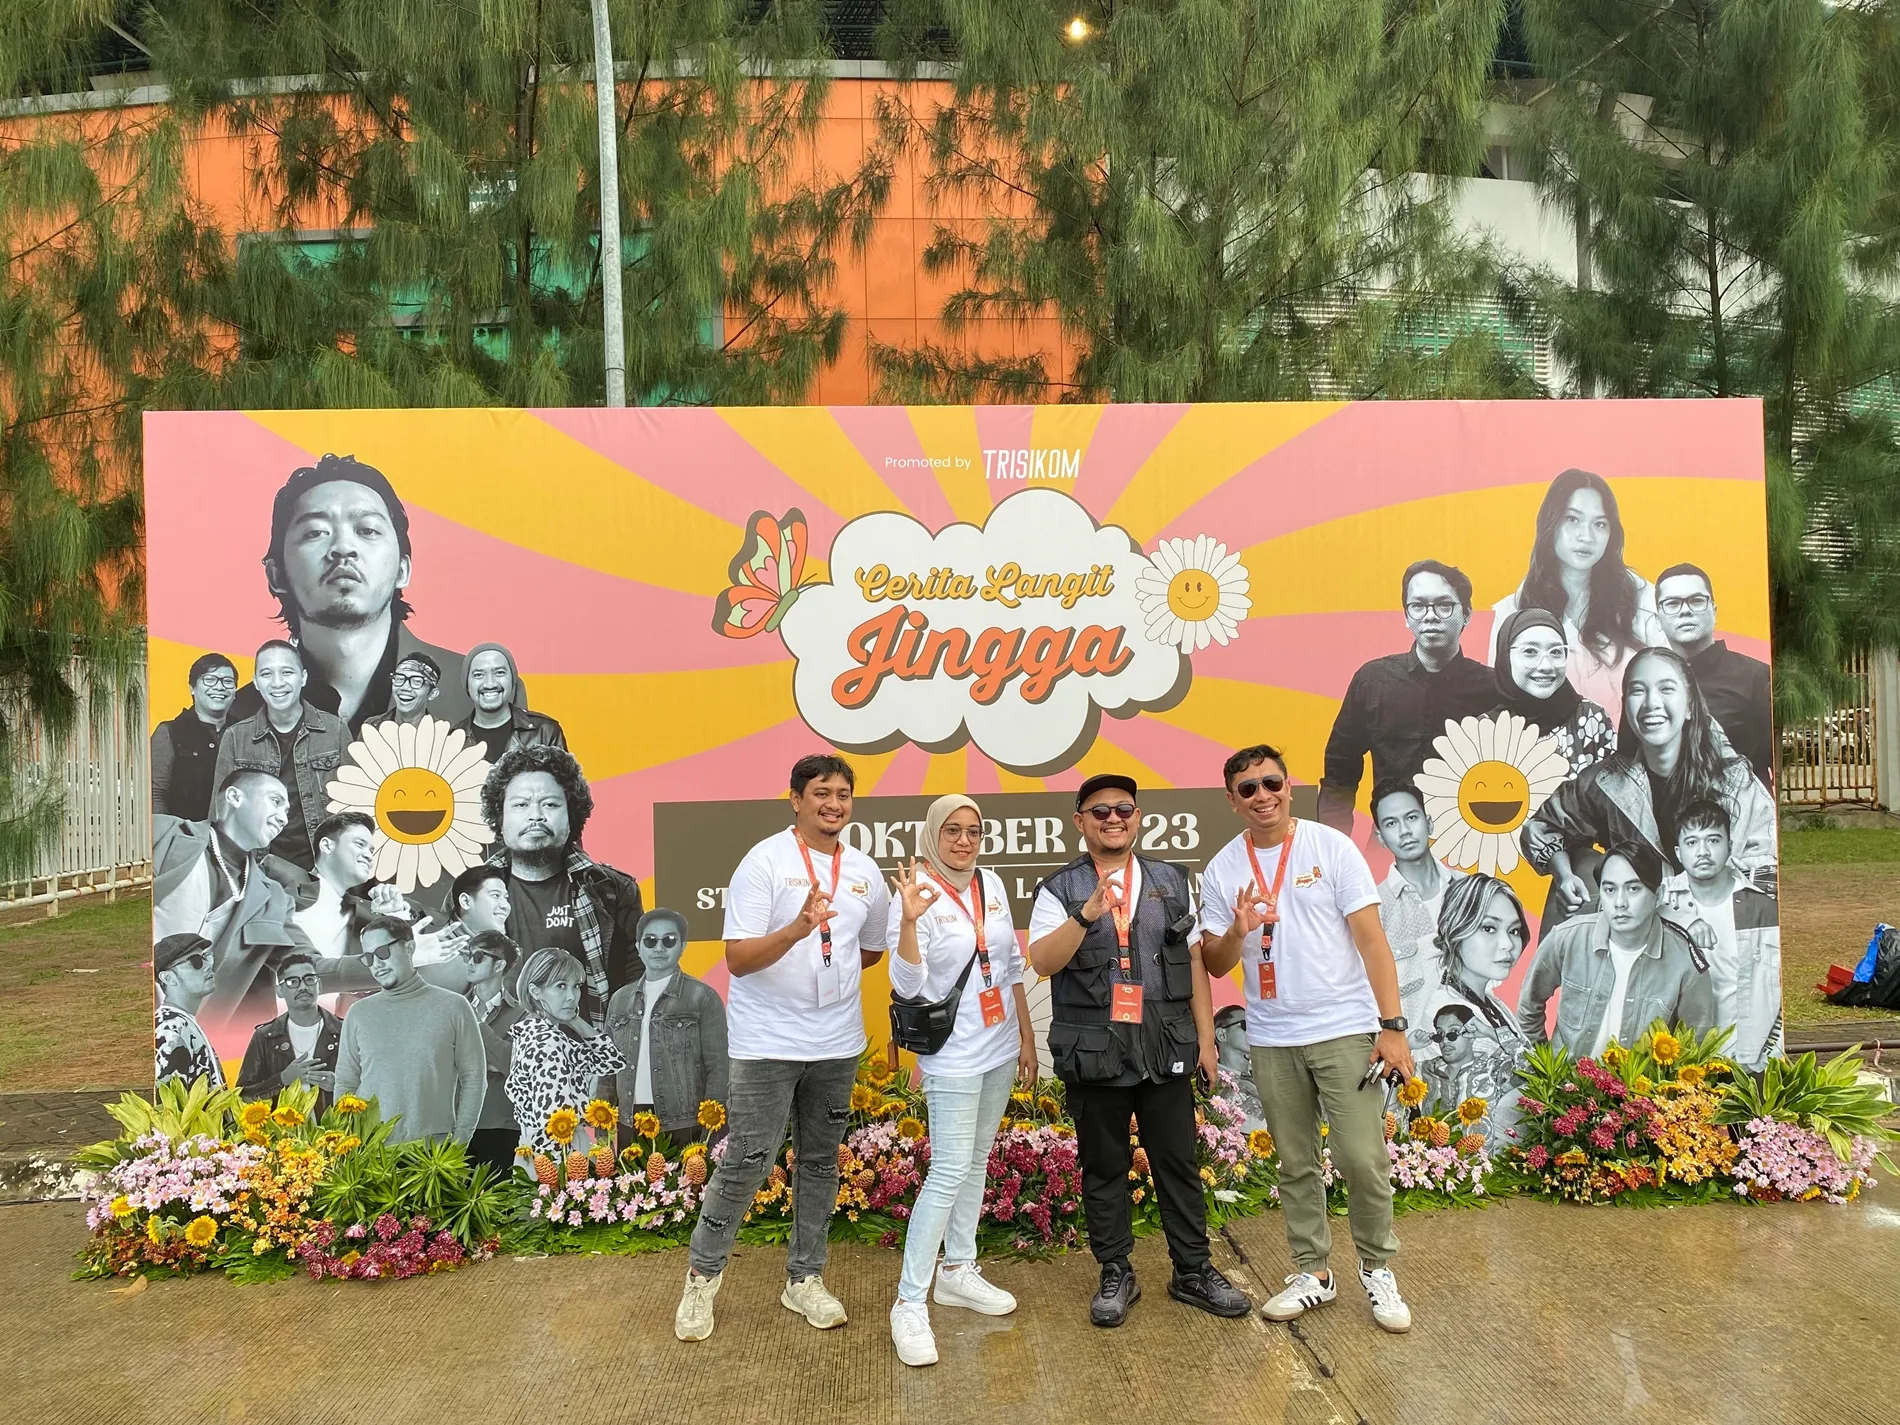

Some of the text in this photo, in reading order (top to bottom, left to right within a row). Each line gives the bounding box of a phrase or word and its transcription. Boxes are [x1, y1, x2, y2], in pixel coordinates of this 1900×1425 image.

[885, 448, 1081, 480] Promoted by TRISIKOM
[854, 561, 1115, 609] Cerita Langit
[831, 604, 1136, 710] Jingga
[838, 817, 1067, 858] OKTBER
[545, 916, 575, 929] DONT
[546, 904, 571, 917] JUST
